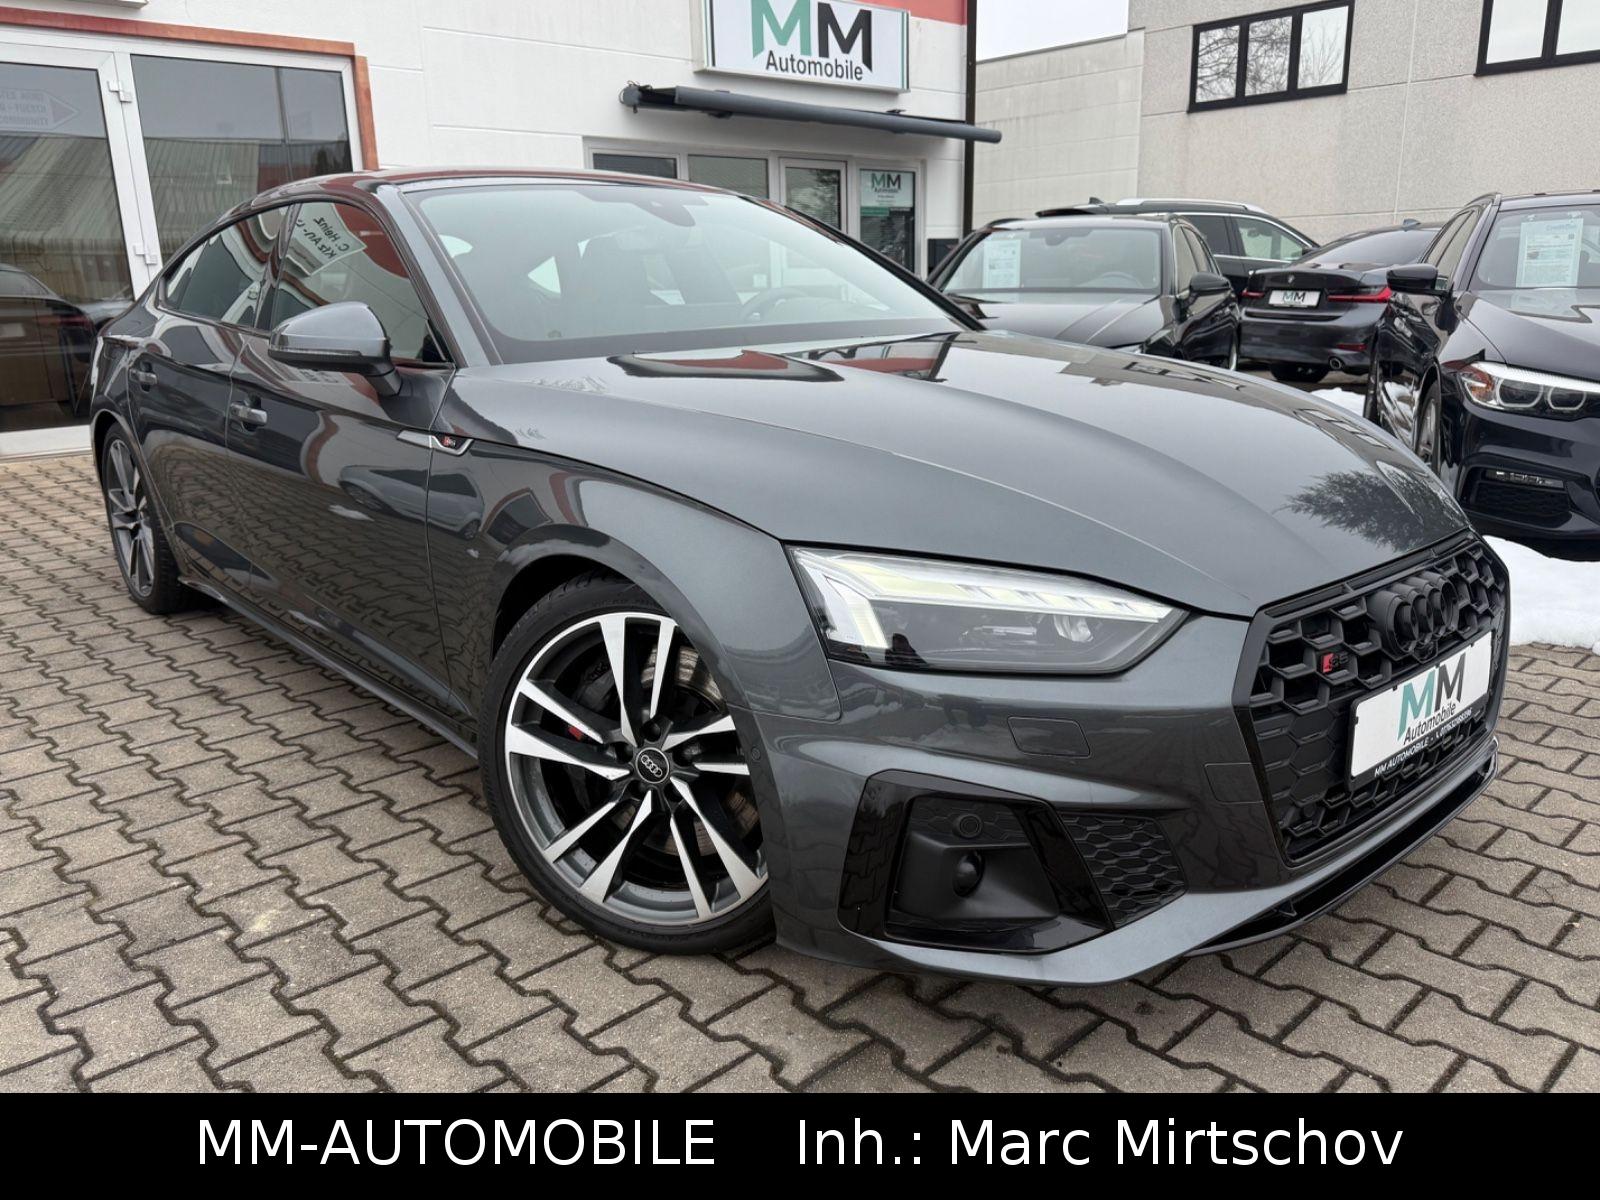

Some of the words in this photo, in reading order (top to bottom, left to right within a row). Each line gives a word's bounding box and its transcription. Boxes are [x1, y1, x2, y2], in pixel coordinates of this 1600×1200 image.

[751, 0, 873, 72] MM
[766, 50, 863, 81] Automobile
[871, 173, 902, 190] MM
[1283, 290, 1307, 303] MM
[1397, 652, 1466, 741] MM
[1403, 702, 1456, 746] Automobile
